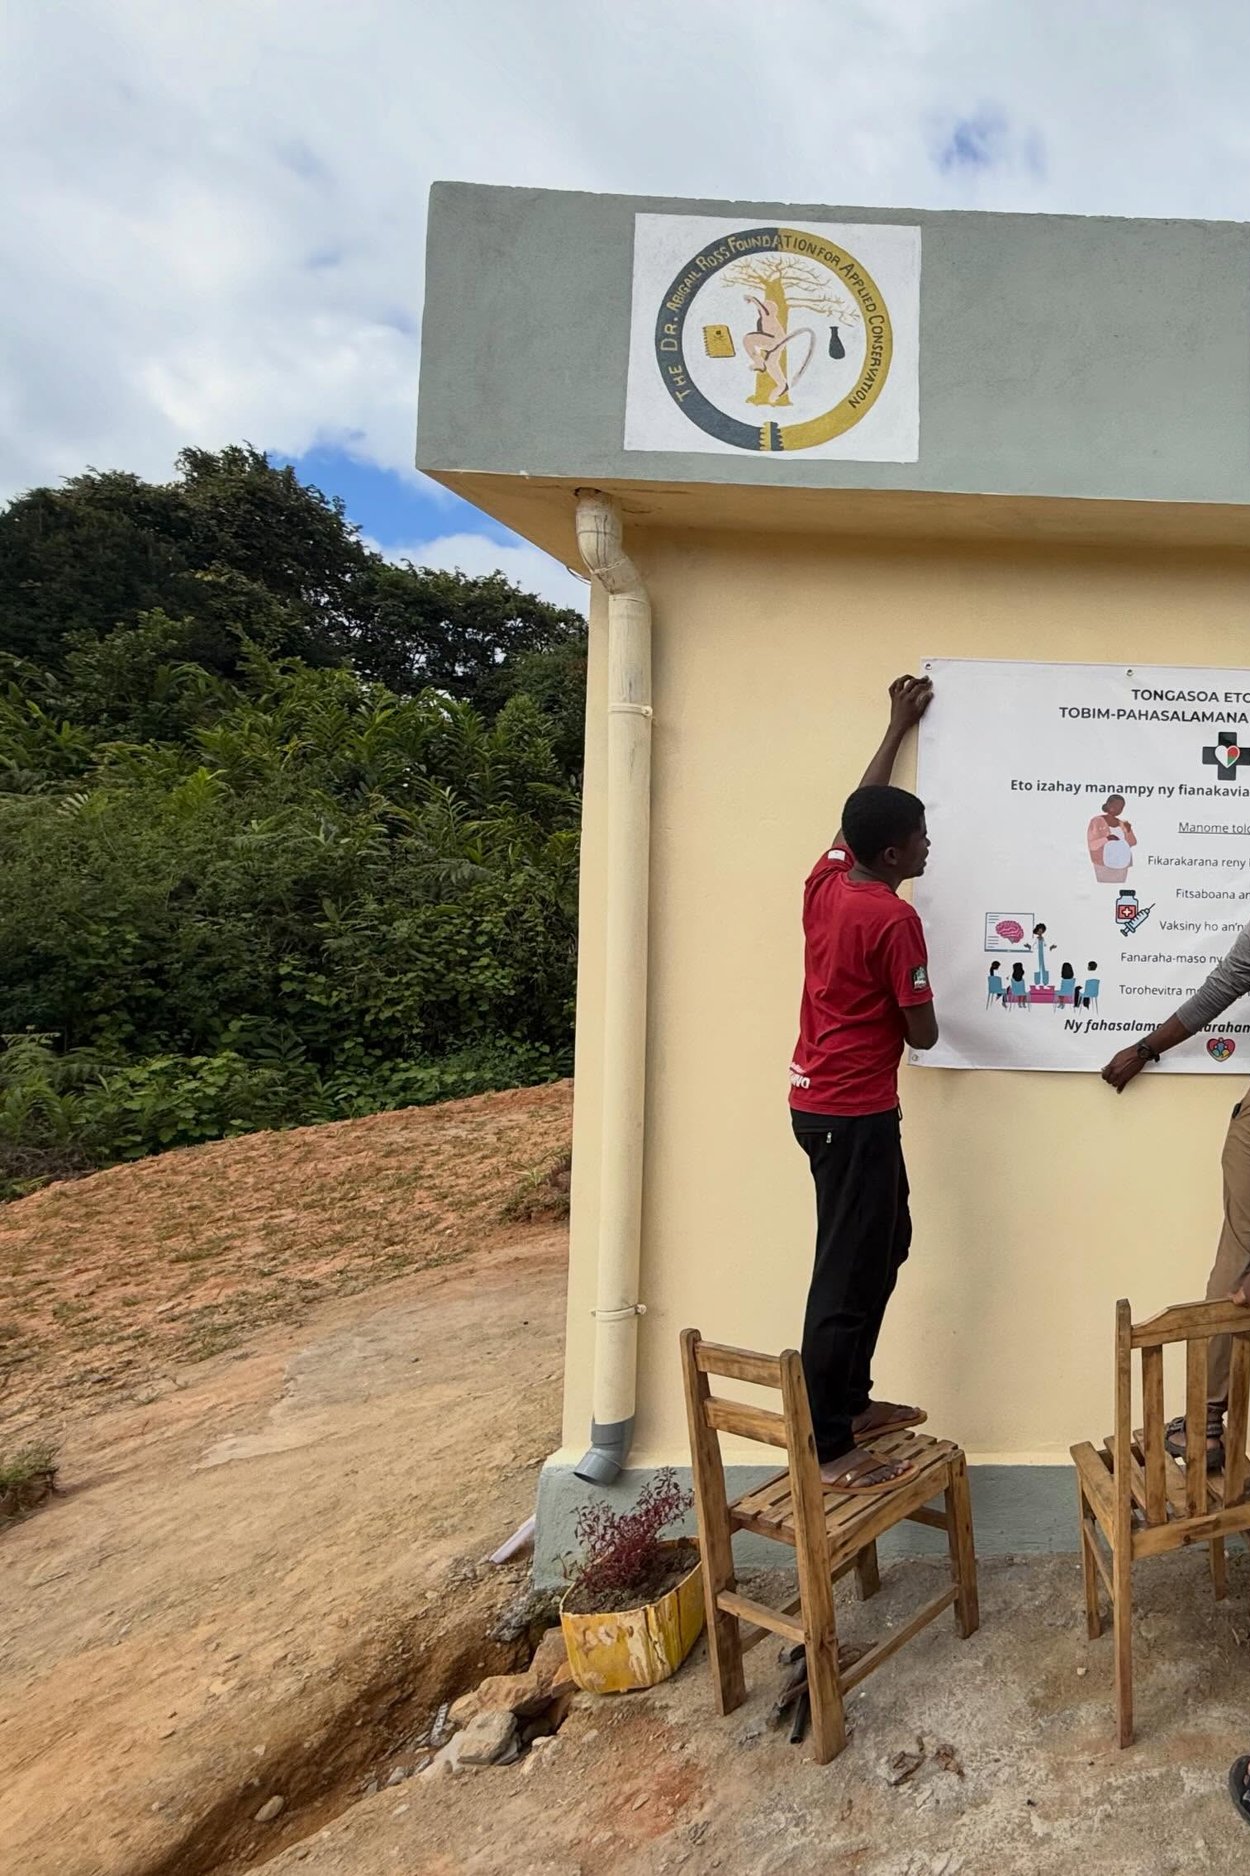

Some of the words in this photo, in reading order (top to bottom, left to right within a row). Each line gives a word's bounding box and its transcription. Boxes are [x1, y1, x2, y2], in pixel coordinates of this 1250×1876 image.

[727, 234, 818, 257] FOUNDATION
[695, 247, 731, 272] ROSS
[816, 246, 841, 267] FOR
[666, 271, 703, 312] ABIGAIL
[839, 263, 878, 313] APPLIED
[660, 316, 679, 352] DR.
[848, 313, 886, 409] CONSERVATION
[668, 364, 692, 403] THE
[1131, 689, 1219, 702] TONGASOA
[1059, 706, 1249, 723] TOBIM-PAHASALAMANA
[1011, 779, 1033, 791] Eto
[1037, 780, 1081, 795] izahay
[1085, 784, 1152, 797] manampy
[1158, 785, 1175, 798] ny
[1178, 821, 1229, 834] Manome
[1148, 855, 1219, 867] Fikarakarana
[1221, 859, 1246, 870] reny
[1176, 888, 1235, 900] Fitsaboana
[1159, 920, 1201, 933] Vaksiny
[1204, 921, 1219, 931] ho
[1221, 922, 1246, 932] an'n
[1120, 952, 1207, 964] Fanaraha-maso
[1119, 984, 1183, 996] Torohevitra
[1064, 1019, 1083, 1033] Ny
